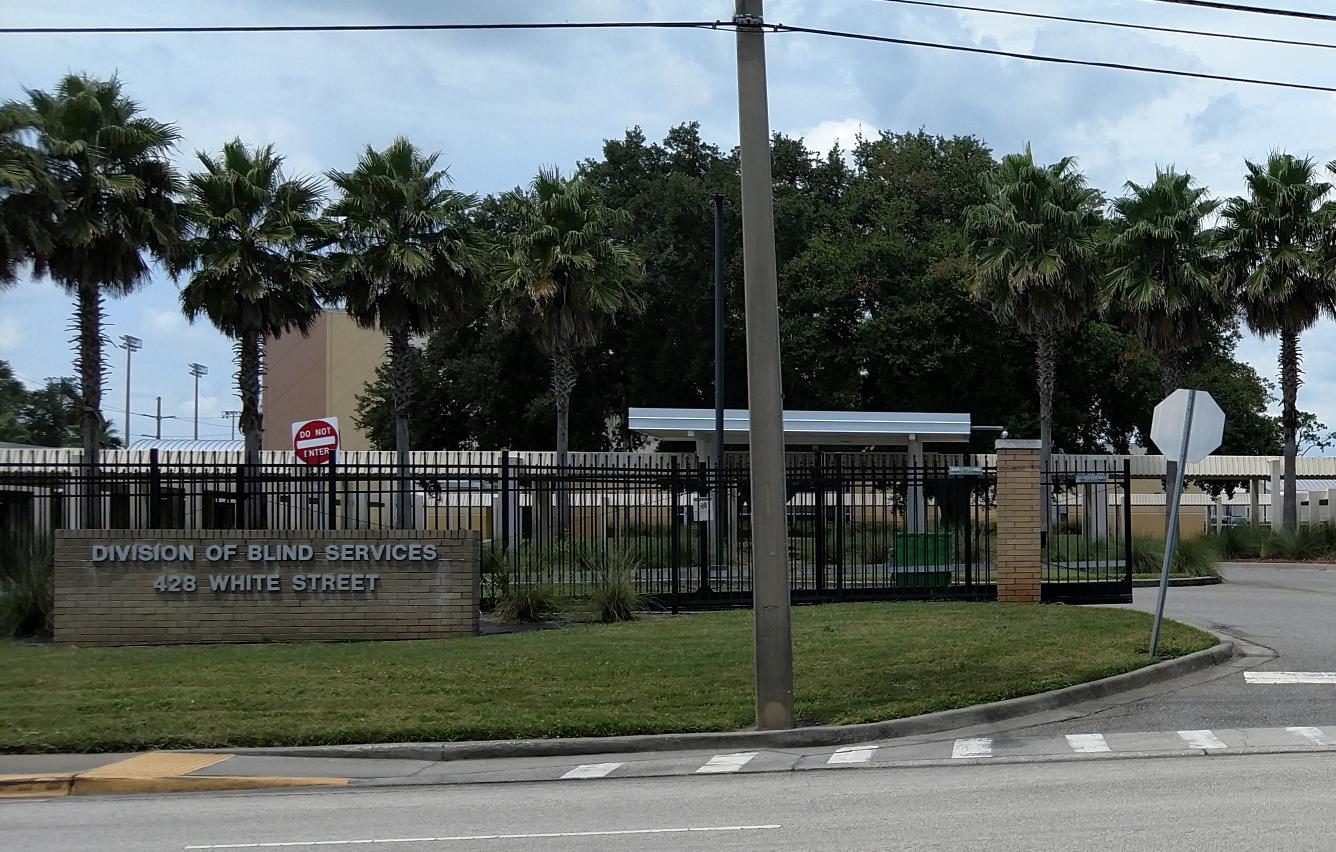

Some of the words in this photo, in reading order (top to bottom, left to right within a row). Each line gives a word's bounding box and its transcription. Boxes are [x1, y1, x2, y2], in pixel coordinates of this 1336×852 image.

[300, 430, 311, 438] DO
[315, 426, 332, 436] NOT
[92, 543, 195, 562] DIVISION
[206, 544, 238, 562] OF
[248, 544, 315, 562] BLIND
[325, 543, 438, 561] SERVICES
[153, 574, 197, 592] 428
[208, 574, 281, 591] WHITE
[292, 574, 380, 591] STREET
